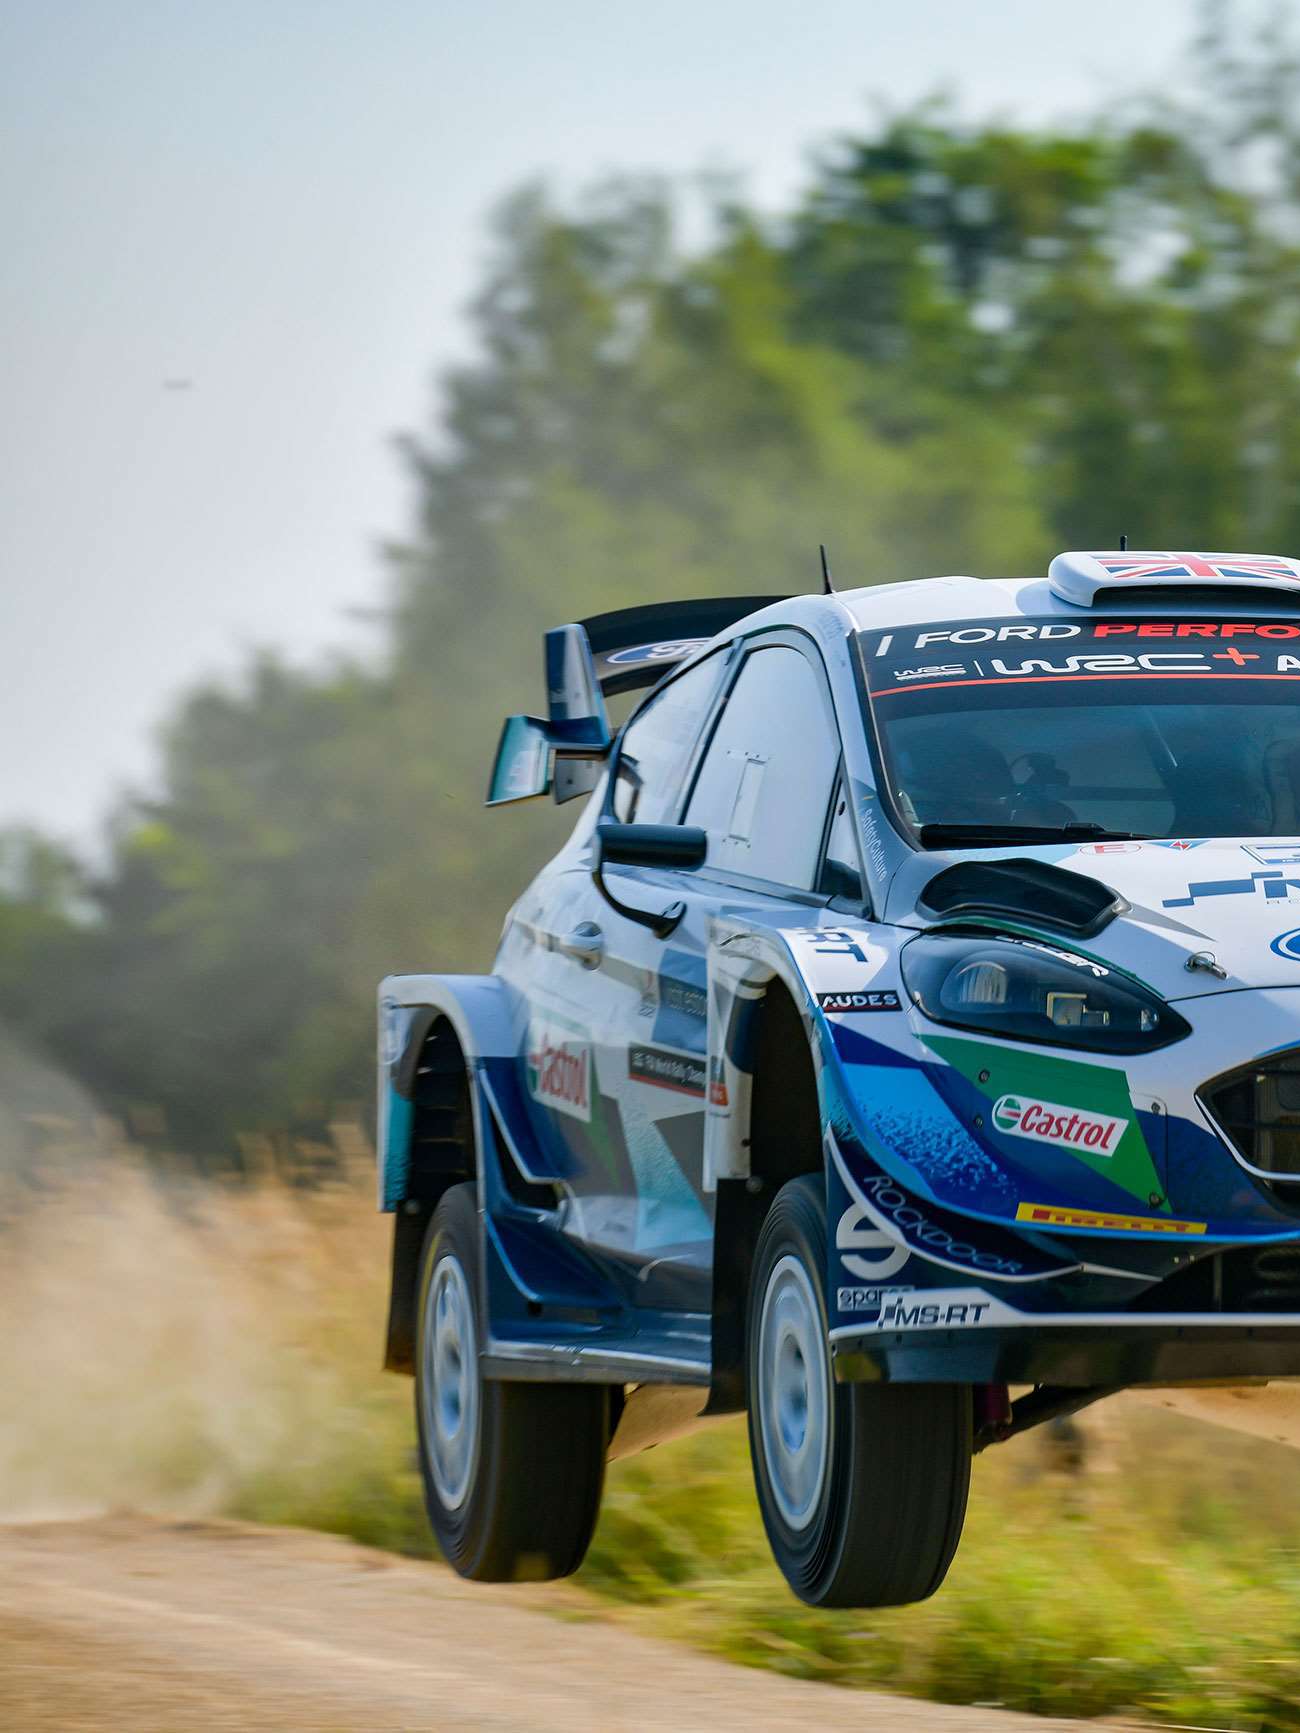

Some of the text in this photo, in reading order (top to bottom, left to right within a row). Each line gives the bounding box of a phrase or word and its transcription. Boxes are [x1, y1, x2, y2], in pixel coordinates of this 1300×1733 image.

[914, 624, 1082, 648] FORD
[1019, 1103, 1118, 1151] Castrol
[863, 1175, 1023, 1273] ROCKDOOR
